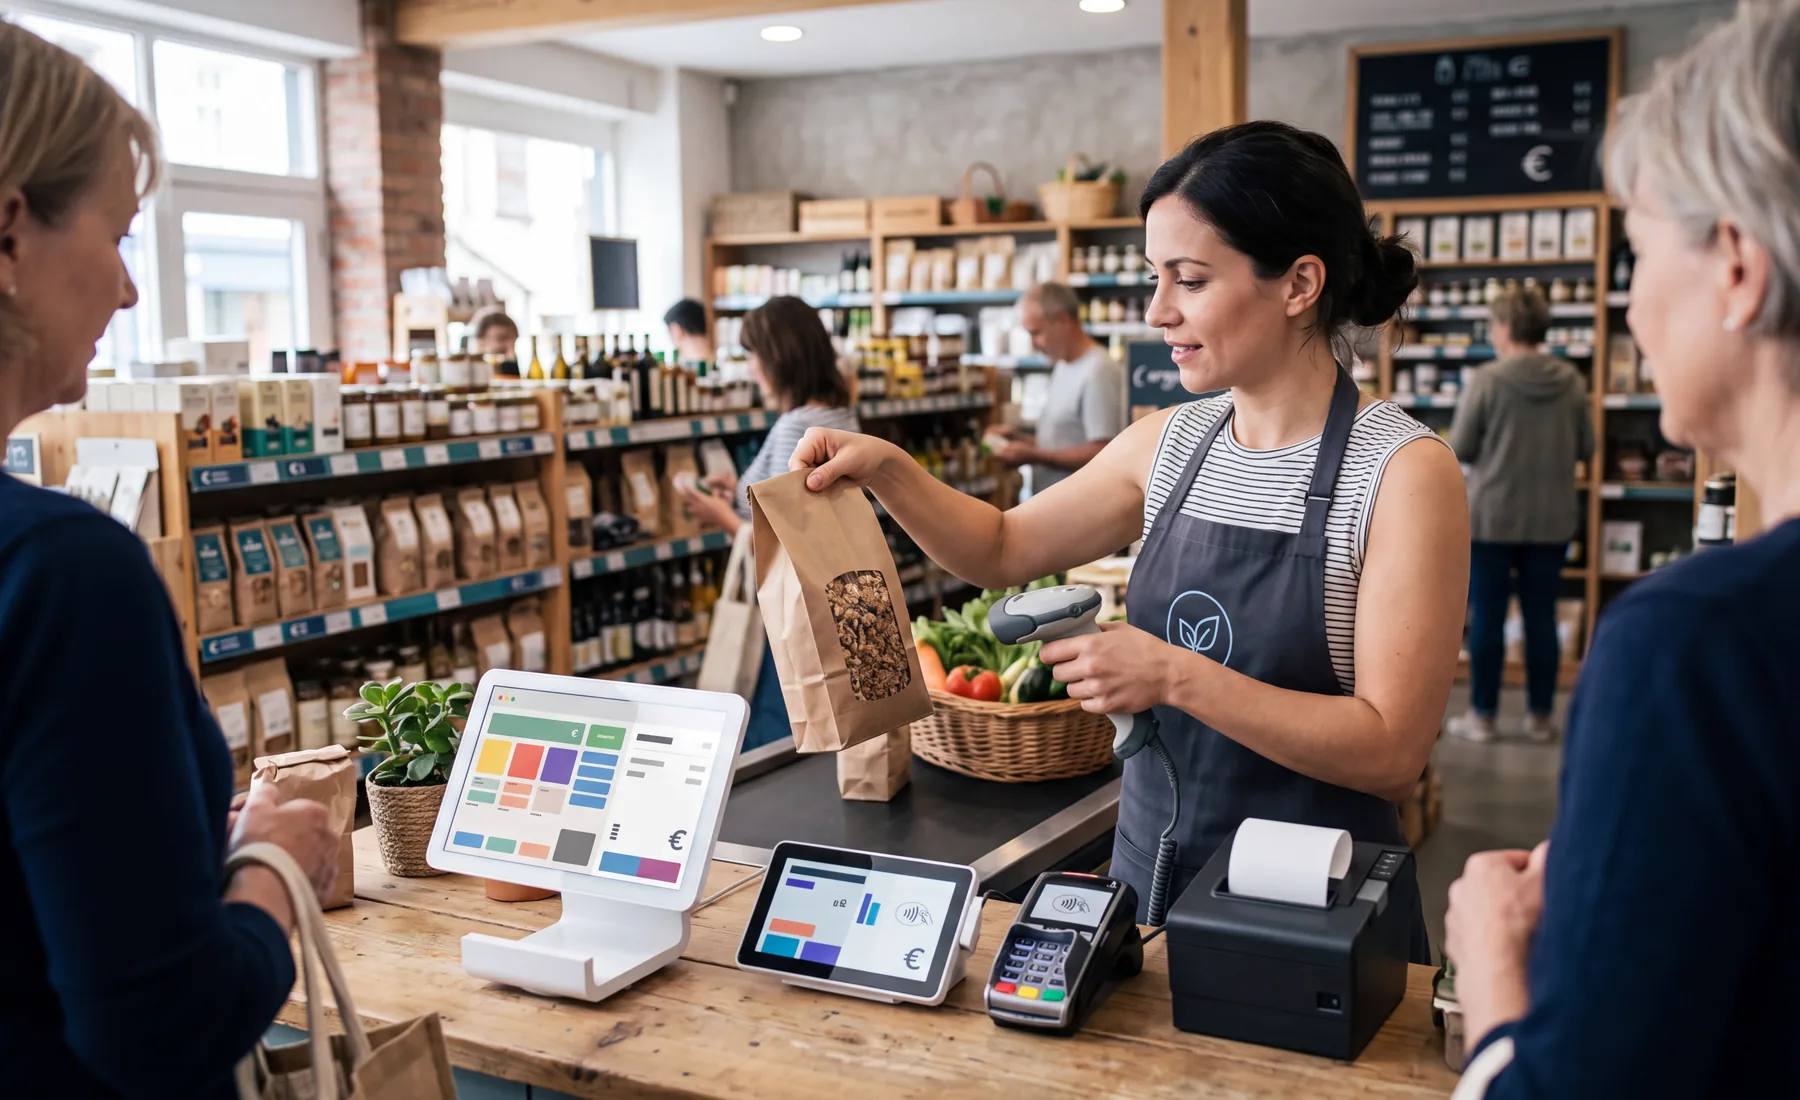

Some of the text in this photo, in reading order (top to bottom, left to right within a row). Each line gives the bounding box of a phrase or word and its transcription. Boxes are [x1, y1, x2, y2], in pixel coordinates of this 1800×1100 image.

[1521, 145, 1553, 182] €
[668, 829, 687, 850] €
[903, 947, 925, 970] €
